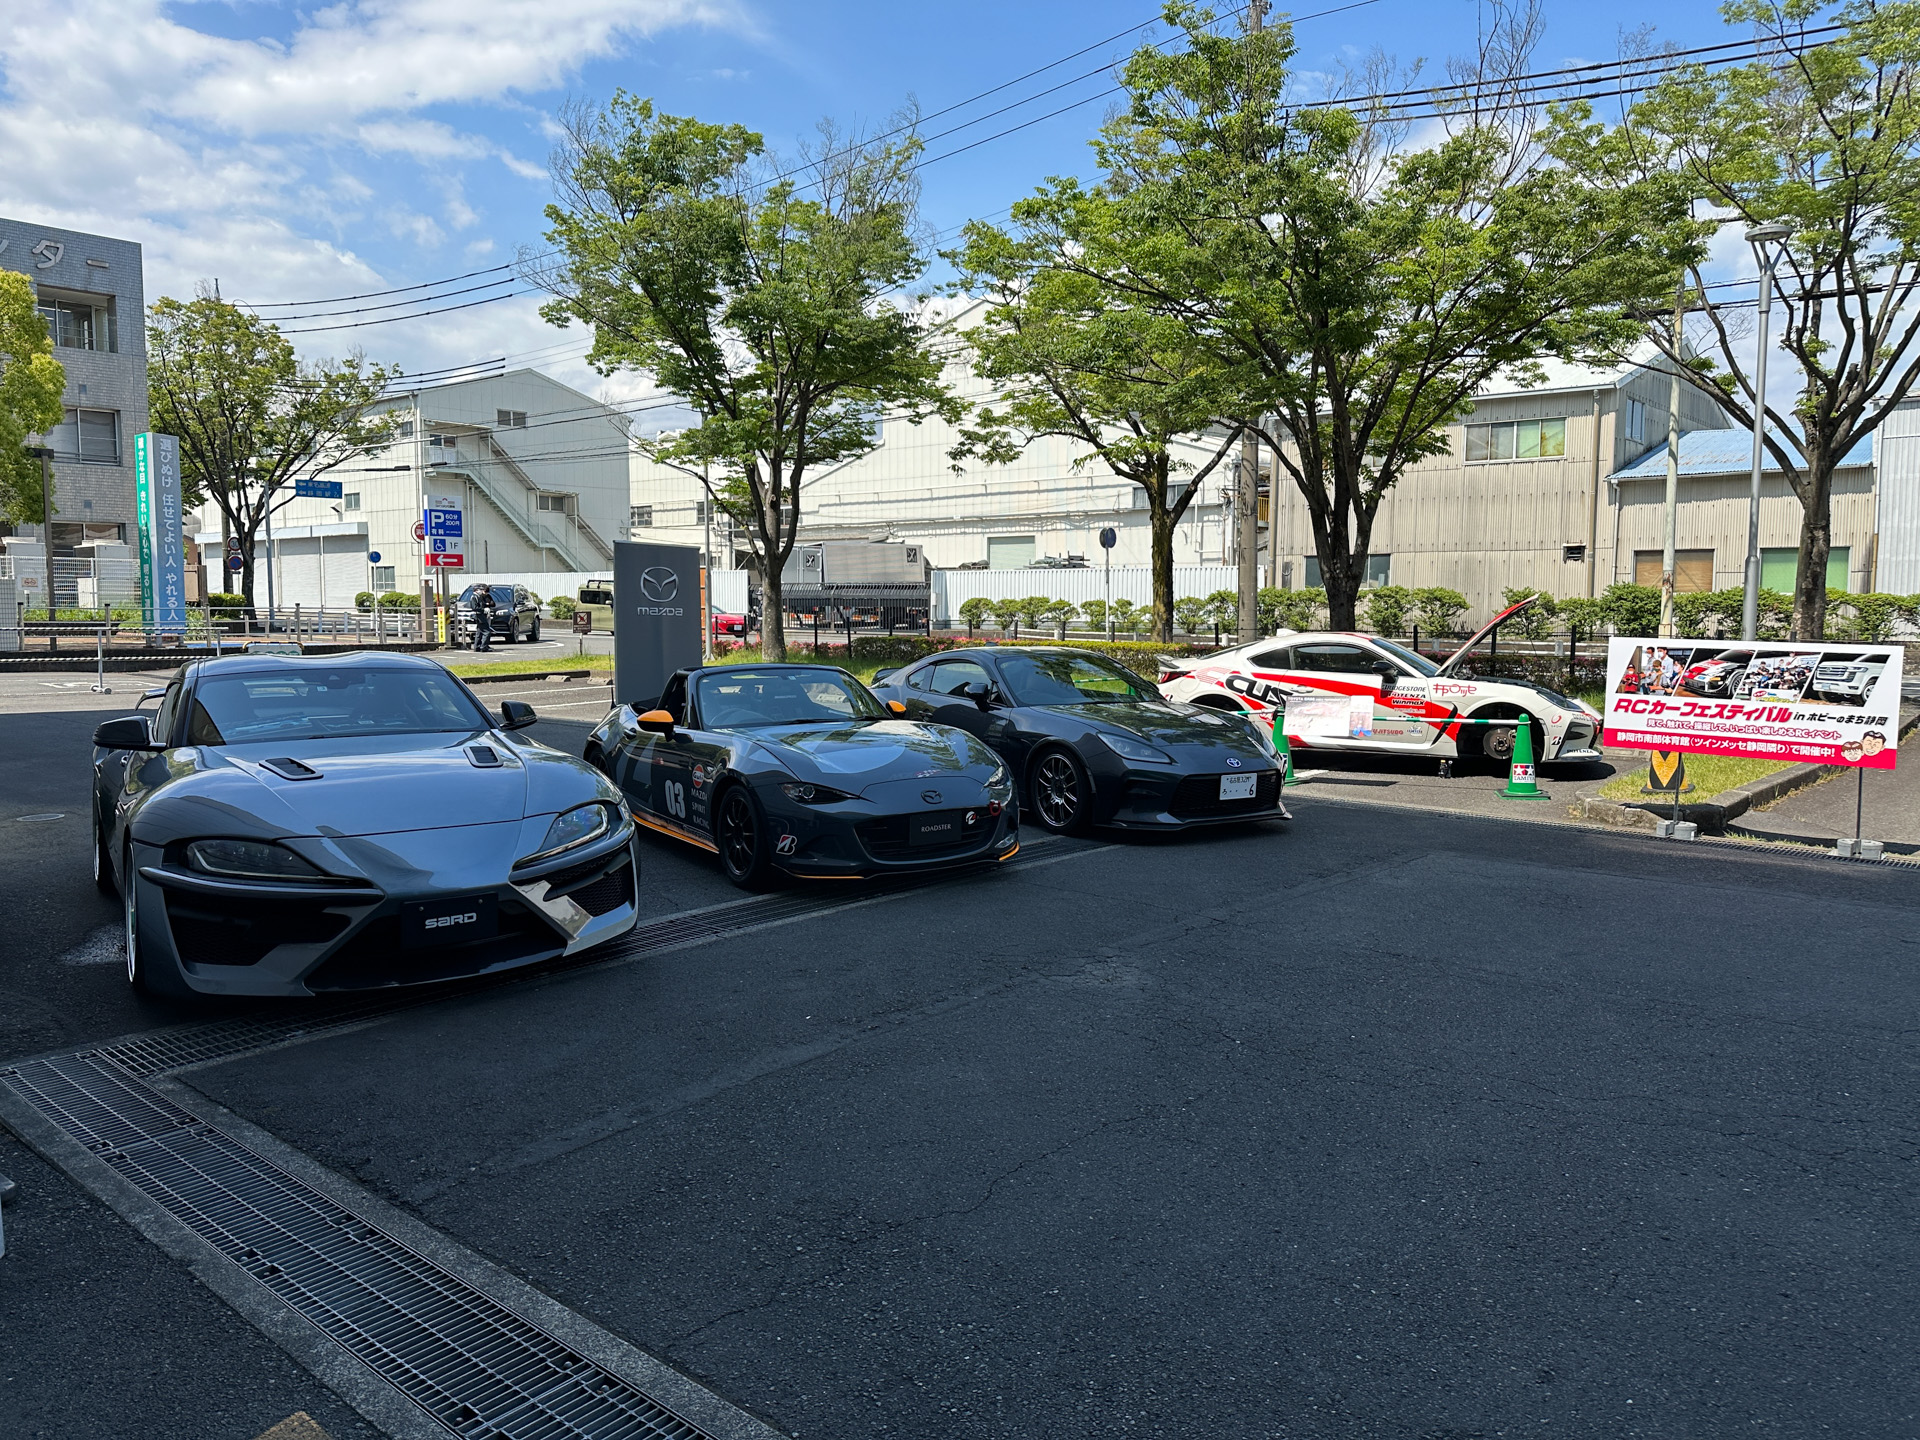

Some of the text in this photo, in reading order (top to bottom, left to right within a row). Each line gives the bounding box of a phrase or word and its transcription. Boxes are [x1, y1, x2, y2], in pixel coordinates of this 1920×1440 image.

[162, 493, 177, 568] 任せてよい人
[431, 511, 445, 527] P
[449, 541, 459, 550] 1F
[165, 572, 179, 621] やれる人
[1613, 698, 1793, 723] RCカーフェスティバル
[1793, 711, 1806, 720] in
[1806, 712, 1889, 726] ホビーのまち静岡
[664, 779, 686, 819] 03
[921, 823, 952, 833] ROADSTER
